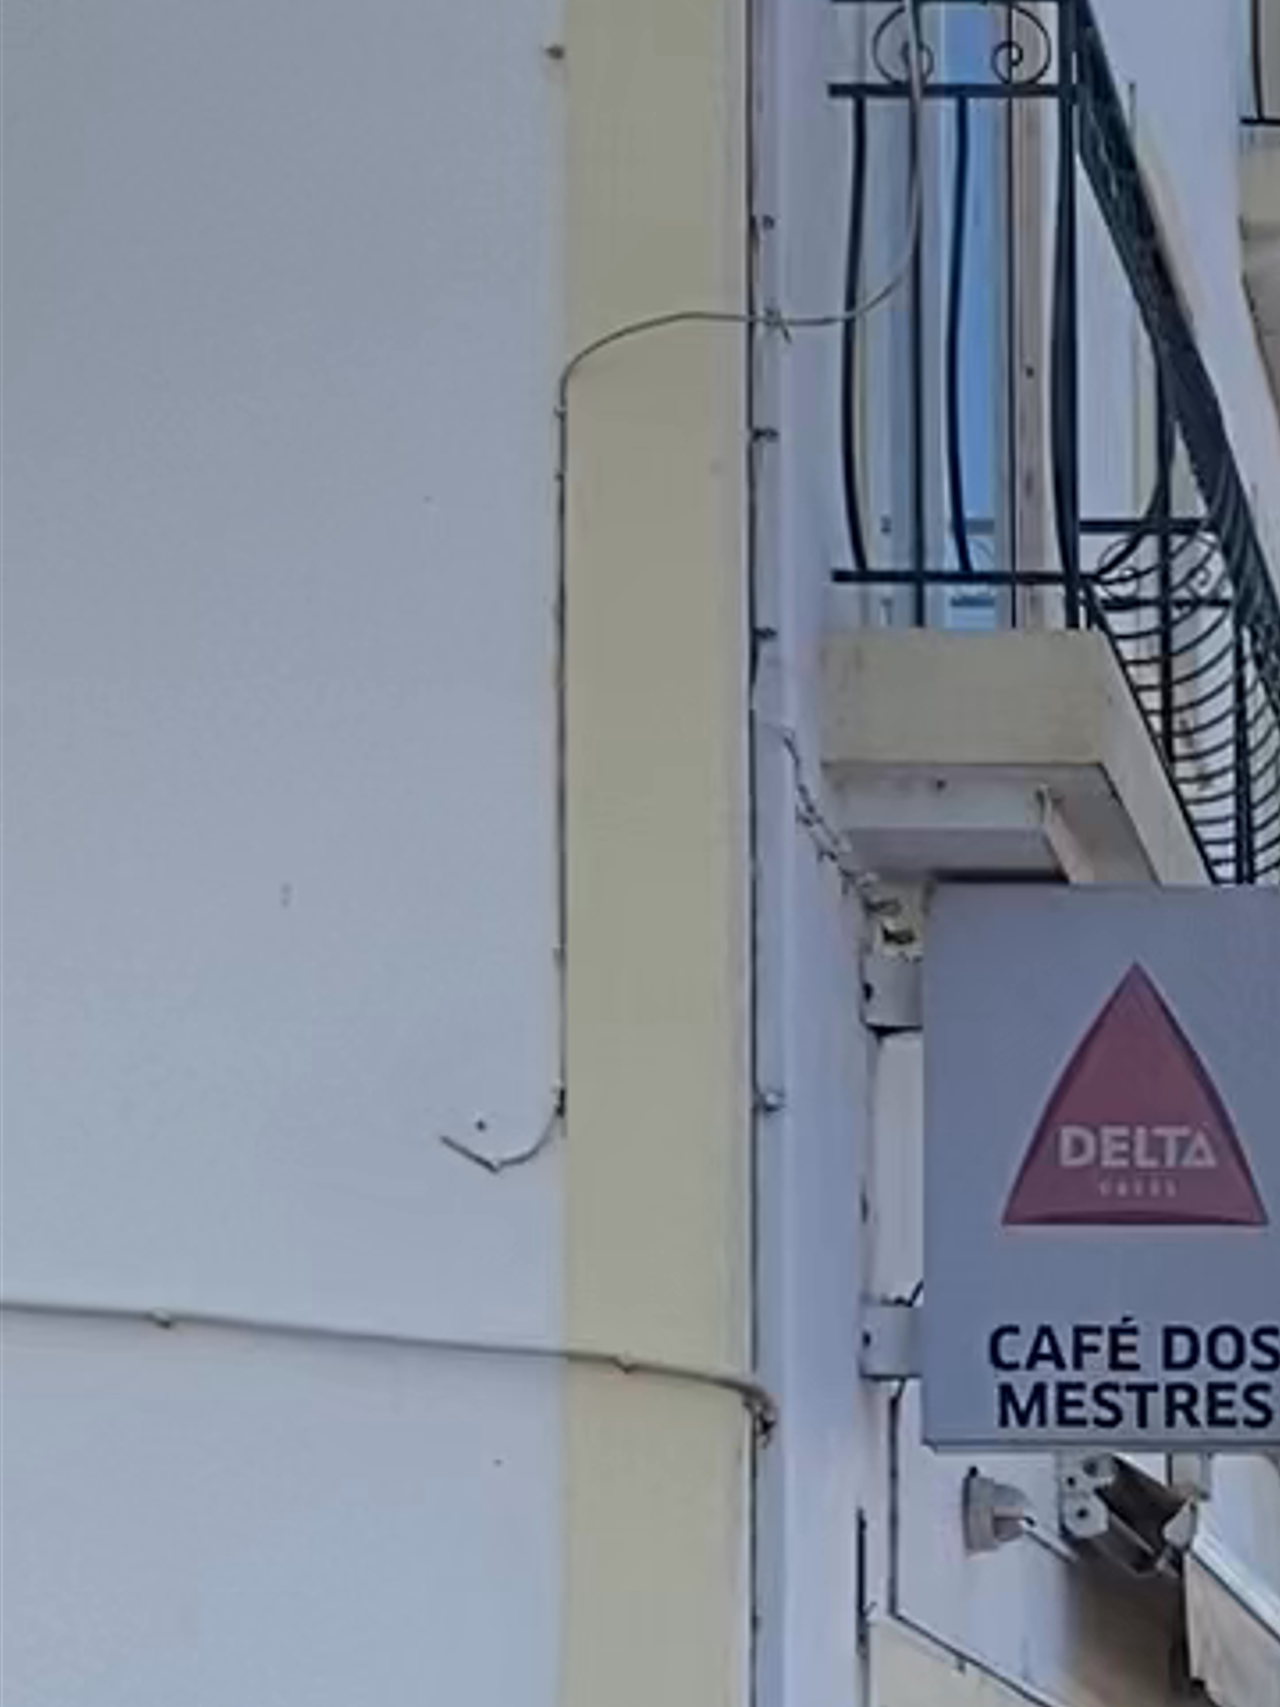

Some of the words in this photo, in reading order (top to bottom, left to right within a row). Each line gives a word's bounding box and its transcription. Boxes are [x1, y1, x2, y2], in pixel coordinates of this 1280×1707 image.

[1060, 1124, 1217, 1168] DELTA
[988, 1315, 1141, 1372] CAFÉ
[998, 1381, 1274, 1428] MESTRES
